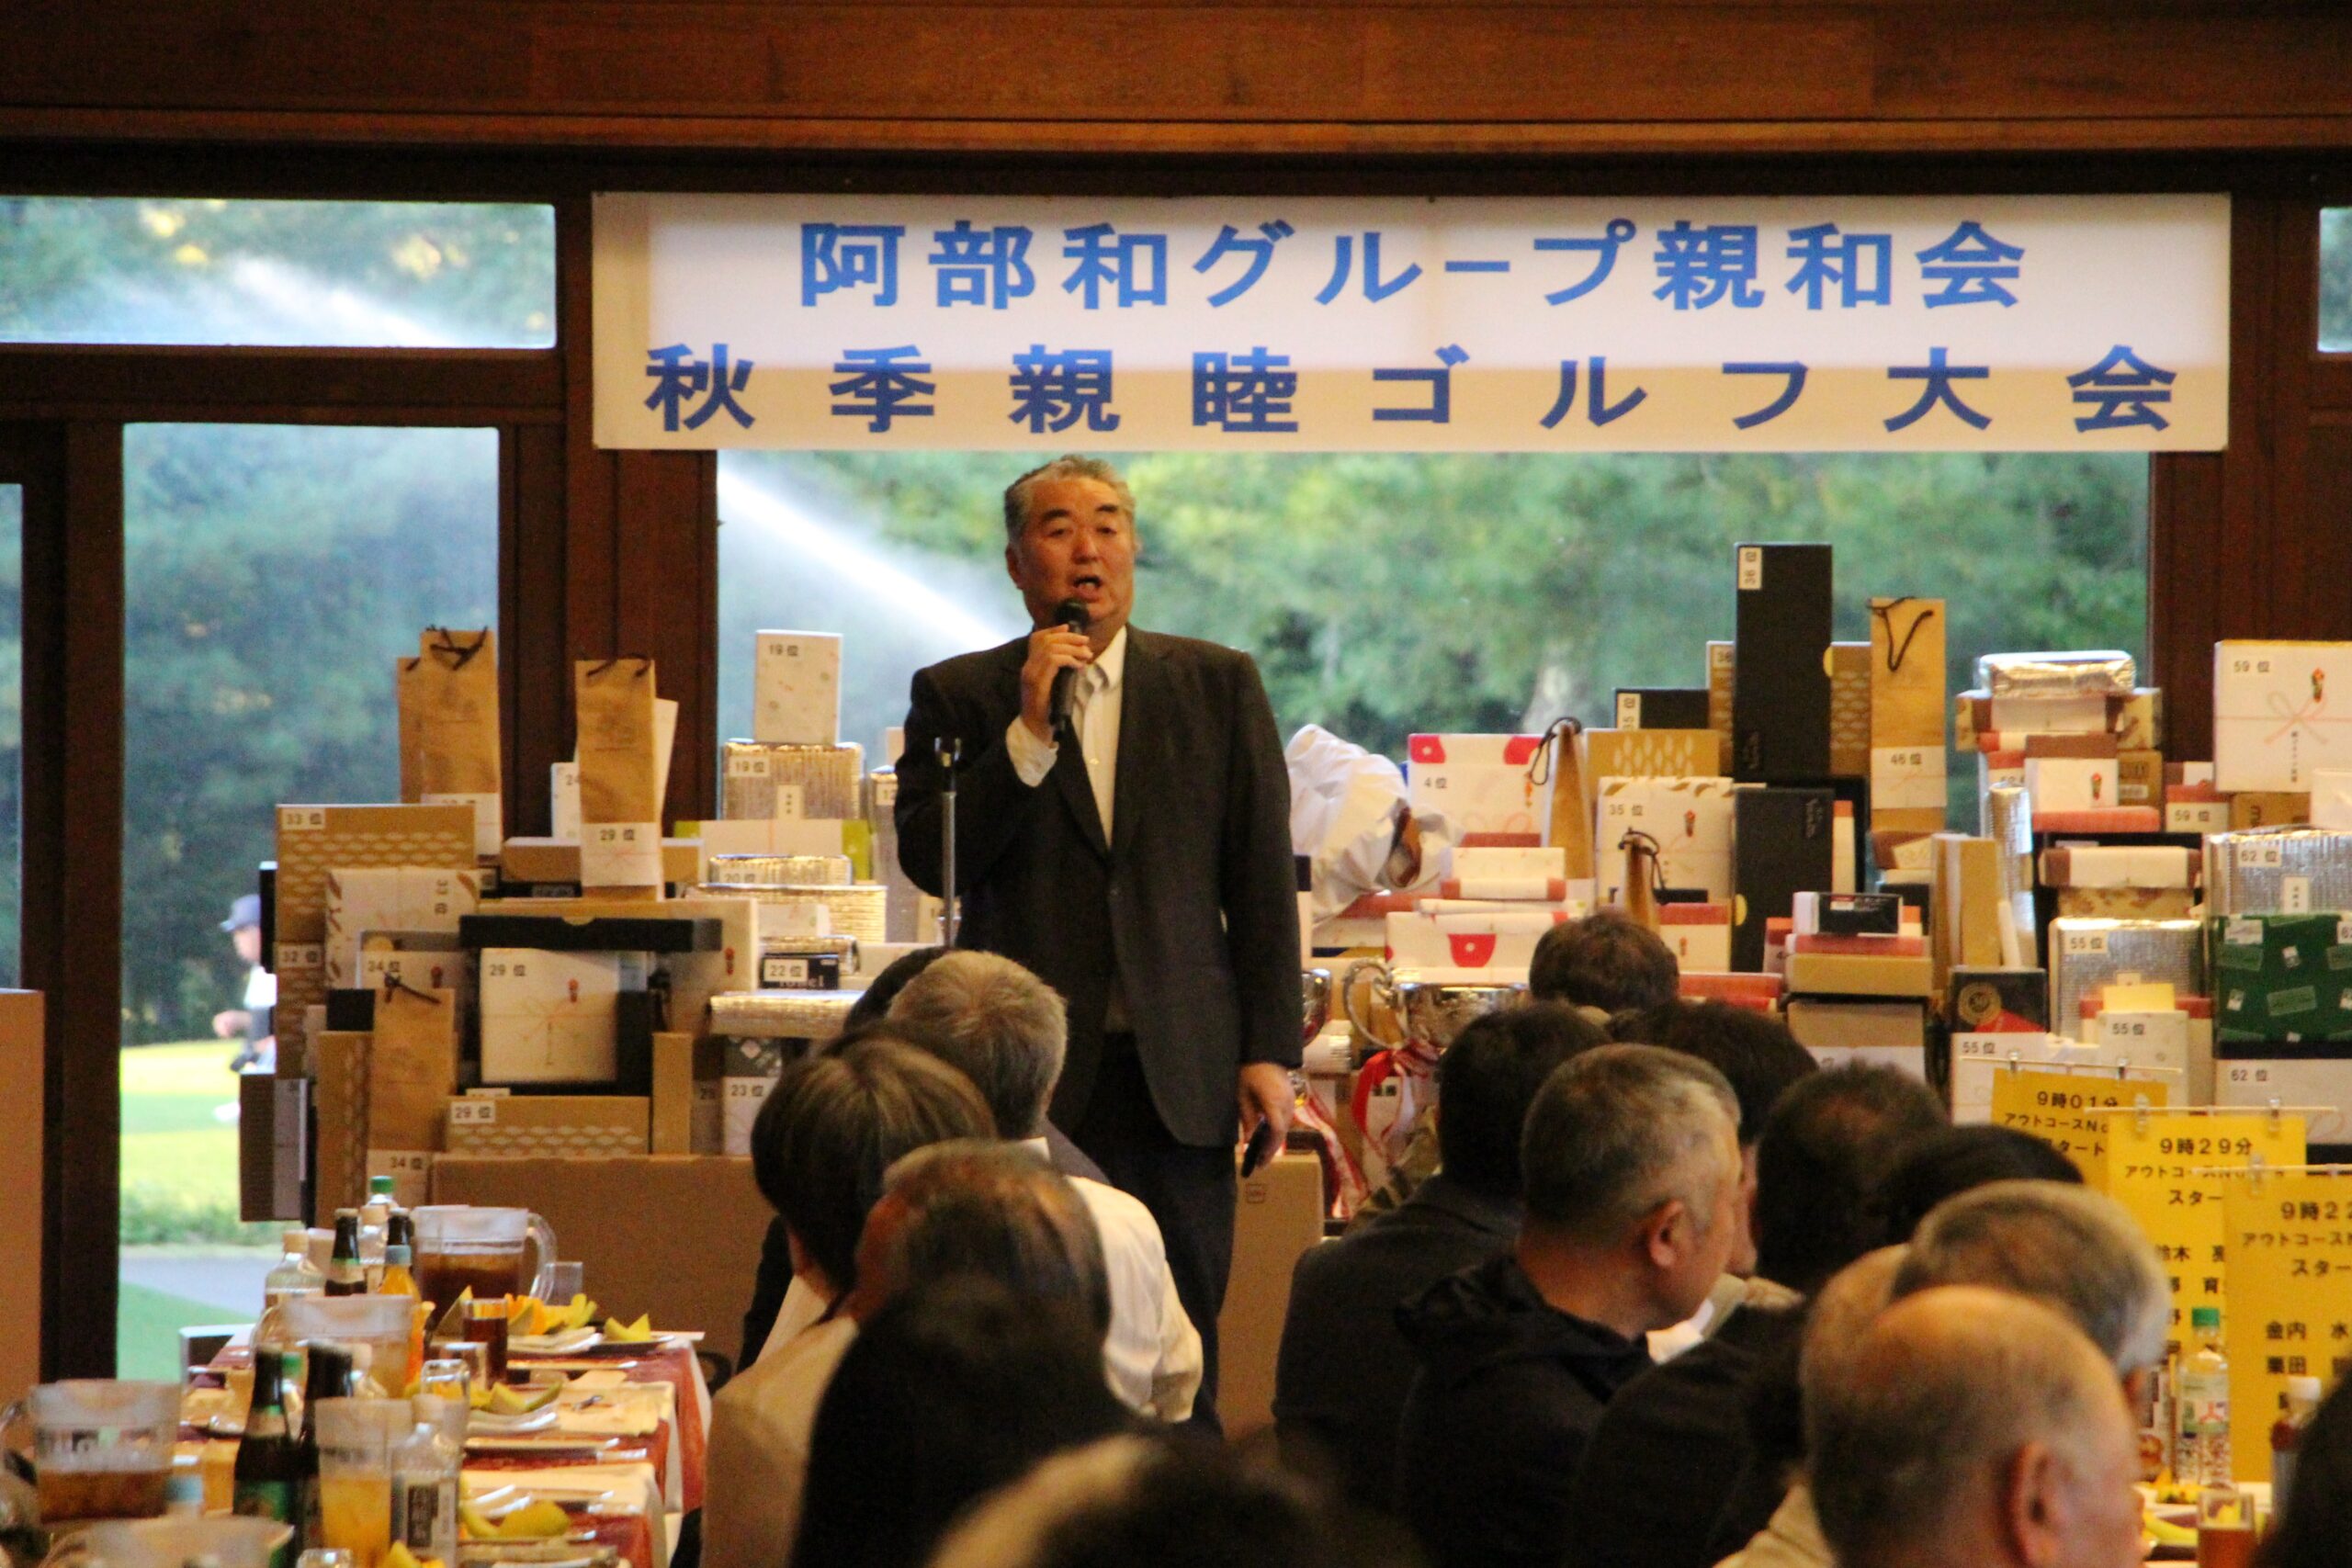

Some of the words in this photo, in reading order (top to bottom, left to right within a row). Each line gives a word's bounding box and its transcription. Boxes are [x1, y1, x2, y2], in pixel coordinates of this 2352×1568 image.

[800, 219, 2025, 310] 阿部和グループ親和会
[645, 344, 2177, 434] 秋季親睦ゴルフ大会
